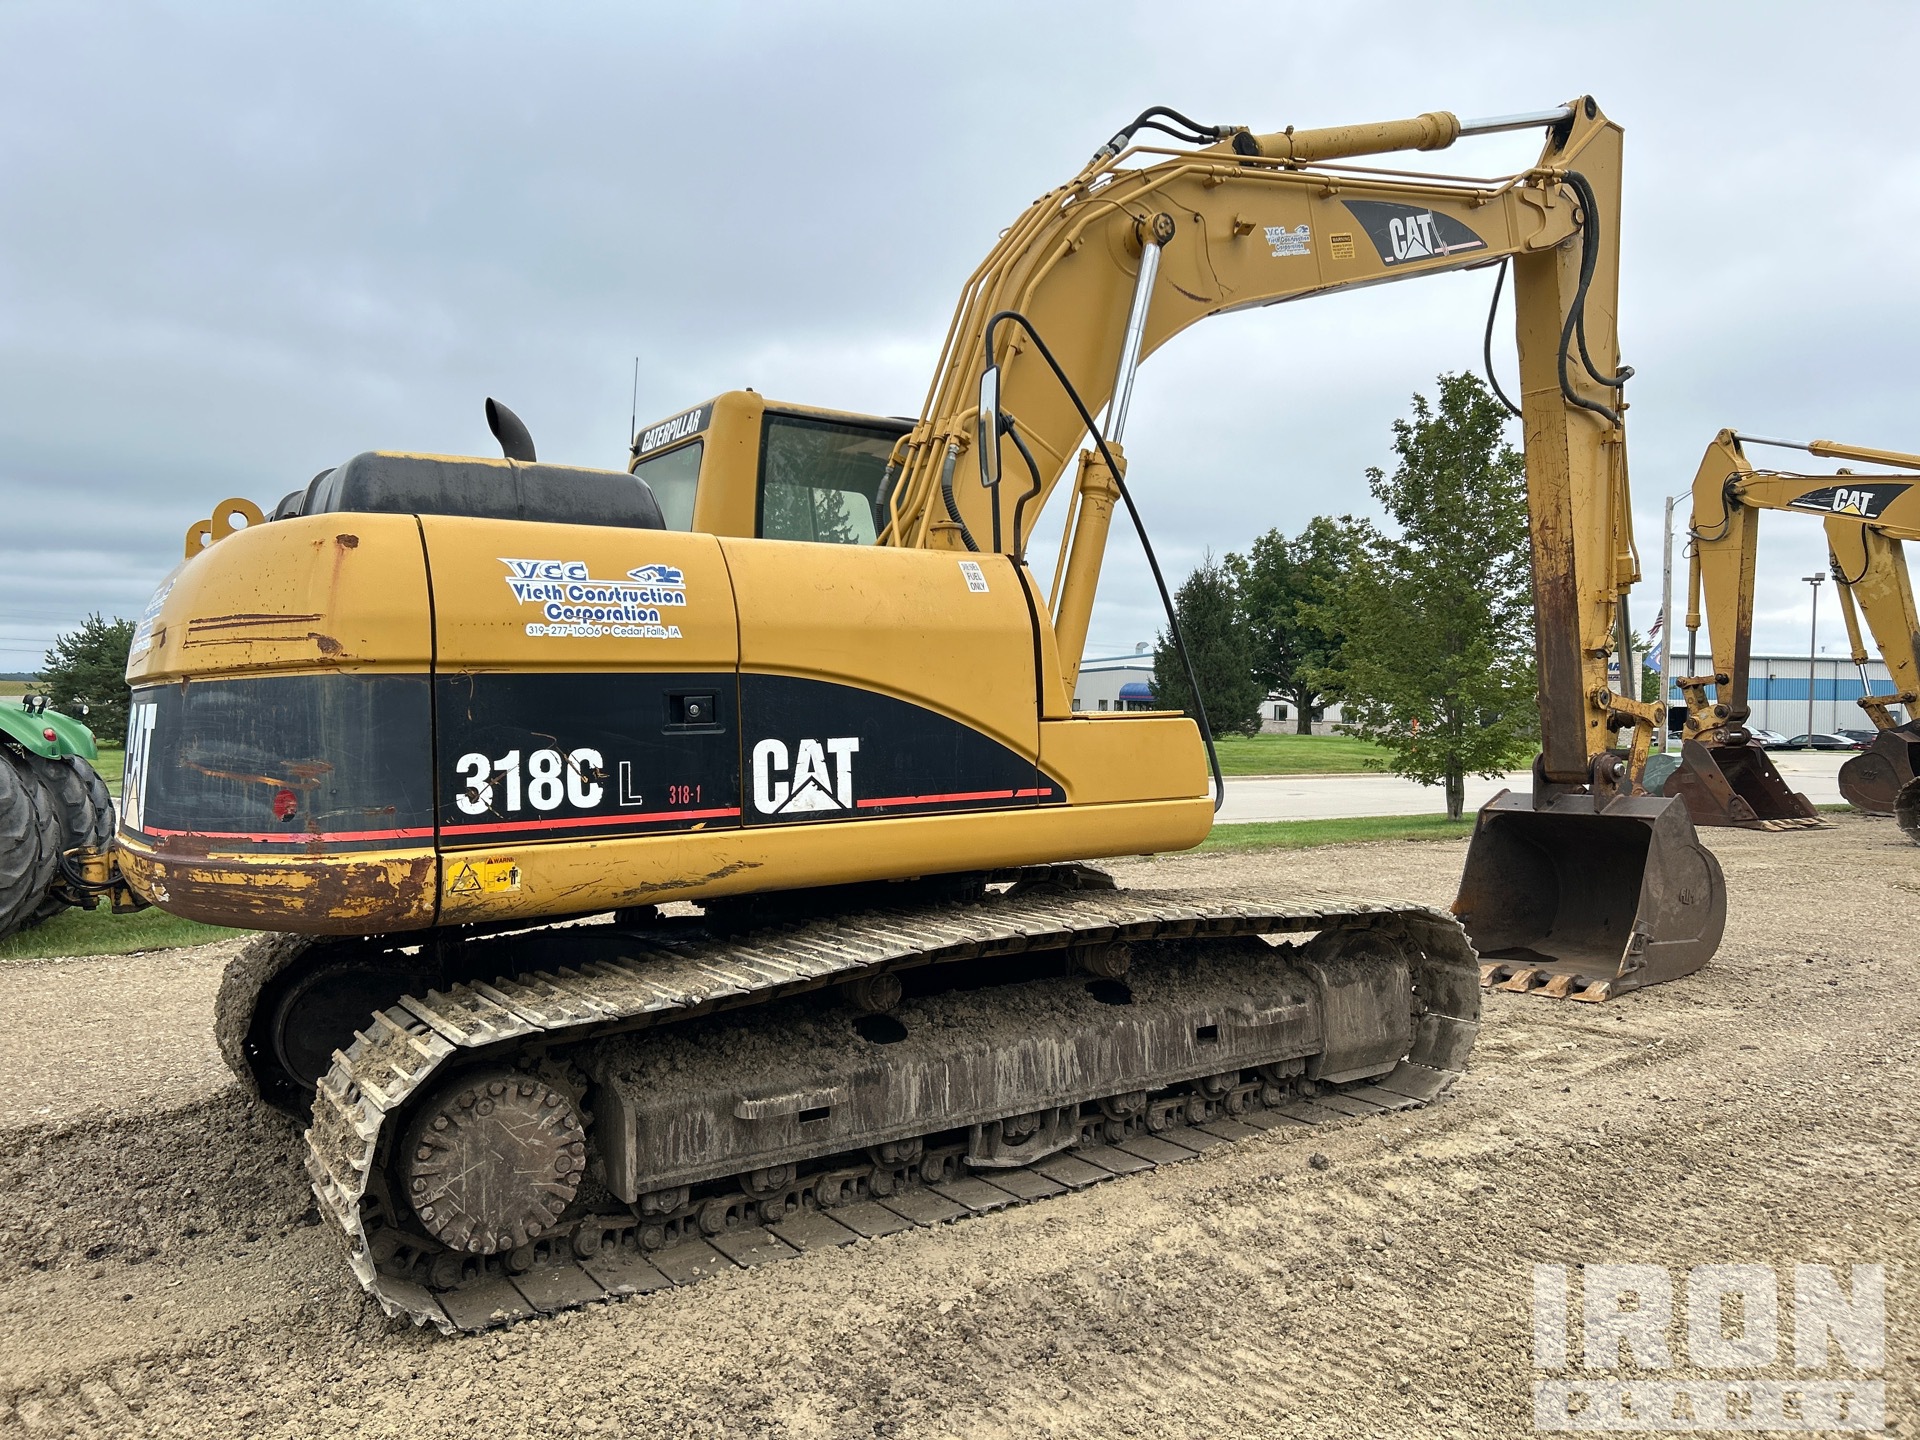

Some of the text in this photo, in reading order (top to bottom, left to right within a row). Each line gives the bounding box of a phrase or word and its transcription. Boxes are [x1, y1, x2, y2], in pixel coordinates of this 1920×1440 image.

[1389, 214, 1433, 260] CAT
[641, 409, 702, 452] CATERPILLAR
[1832, 488, 1874, 516] CAT
[506, 561, 588, 581] VCC
[966, 572, 982, 581] FUEL
[513, 582, 685, 604] Vieth Construction
[970, 582, 986, 591] ONLY
[546, 603, 659, 624] Corporation
[528, 625, 680, 637] 319-277-1006 Cedar Falls, IA
[121, 702, 158, 832] CAT
[752, 737, 860, 814] CAT
[455, 748, 643, 815] 318C L
[669, 784, 701, 804] 318-1
